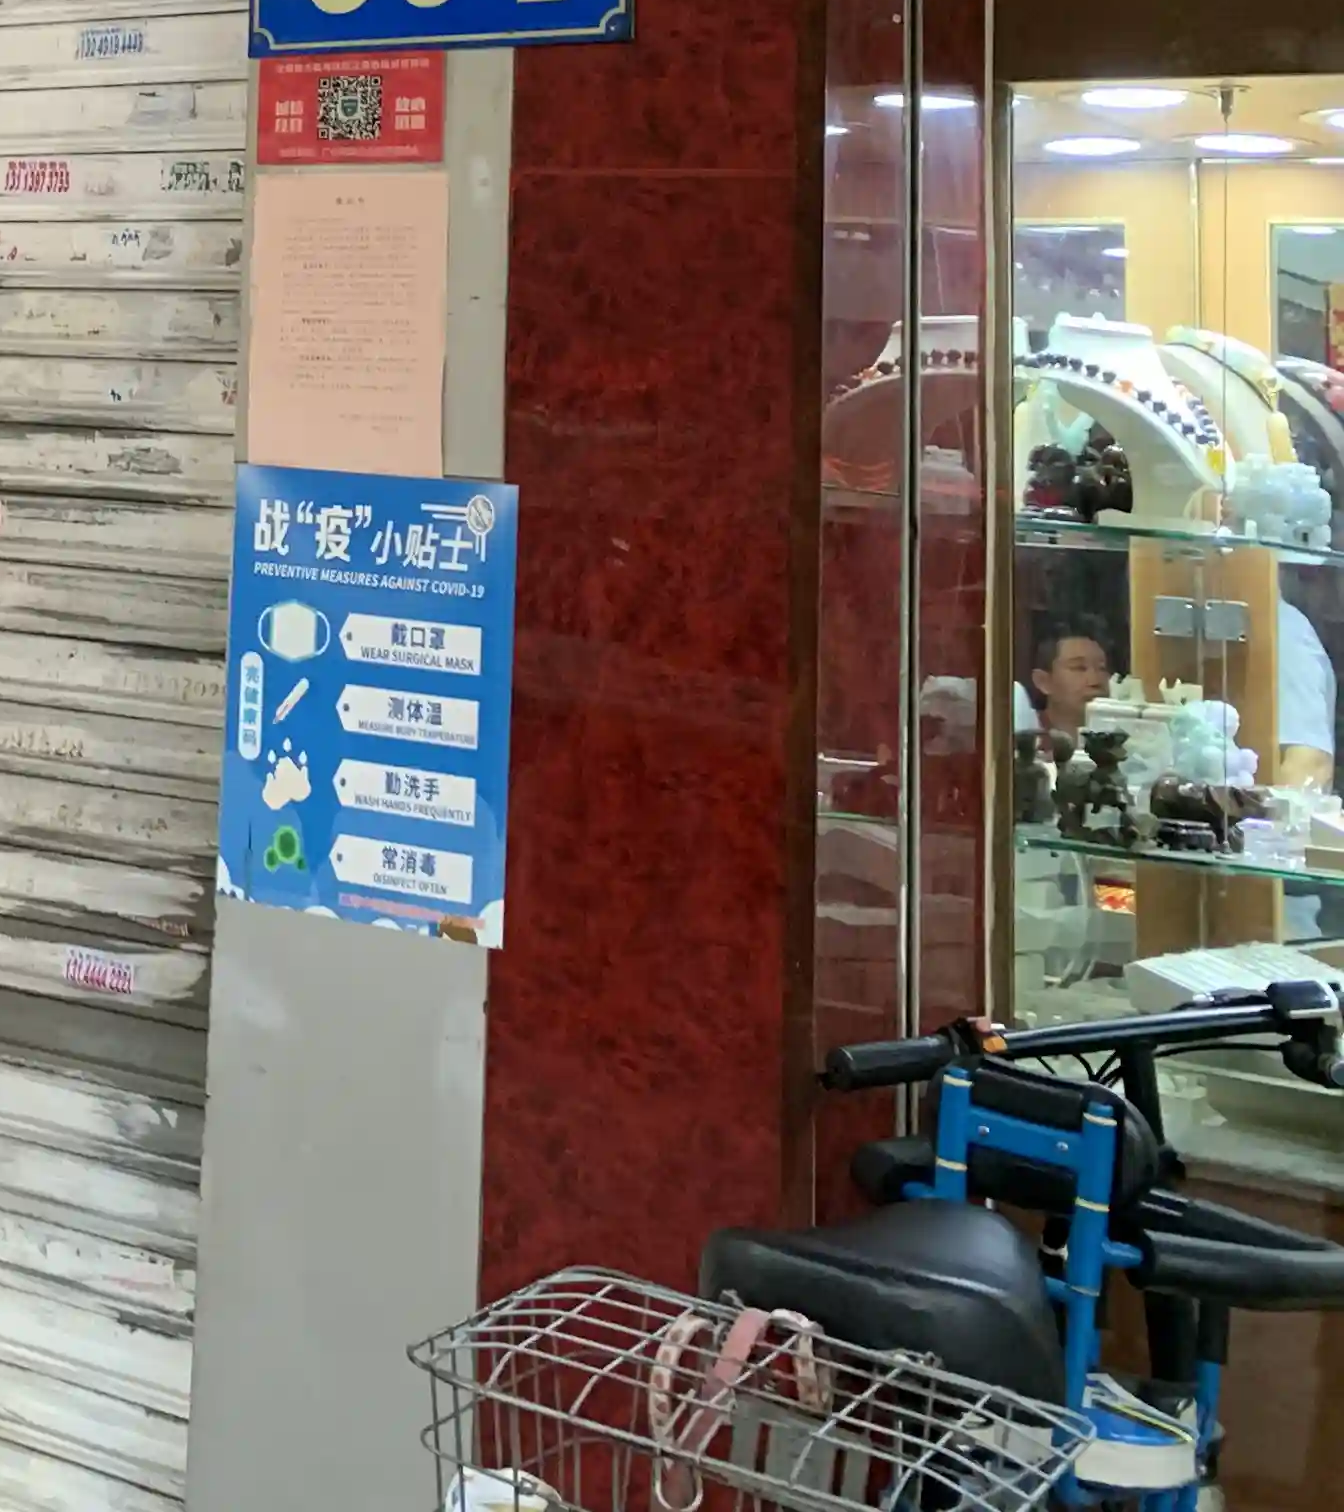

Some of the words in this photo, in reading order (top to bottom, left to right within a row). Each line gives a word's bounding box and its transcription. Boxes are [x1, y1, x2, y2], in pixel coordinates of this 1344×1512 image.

[253, 561, 318, 581] PREVENTIVE
[320, 568, 379, 588] MEASURES
[380, 576, 429, 593] AGAINST
[430, 580, 485, 599] COVID-19
[391, 621, 446, 651] 戴口罩
[360, 646, 390, 663] WEAR
[391, 649, 443, 669] SURGICAL
[445, 656, 475, 672] MASK
[387, 696, 443, 726] 测体温
[384, 771, 440, 802] 勤洗手
[354, 793, 381, 809] WASH
[382, 797, 412, 814] HANDS
[412, 801, 472, 822] FREQUENTLY
[381, 844, 437, 876] 常消毒
